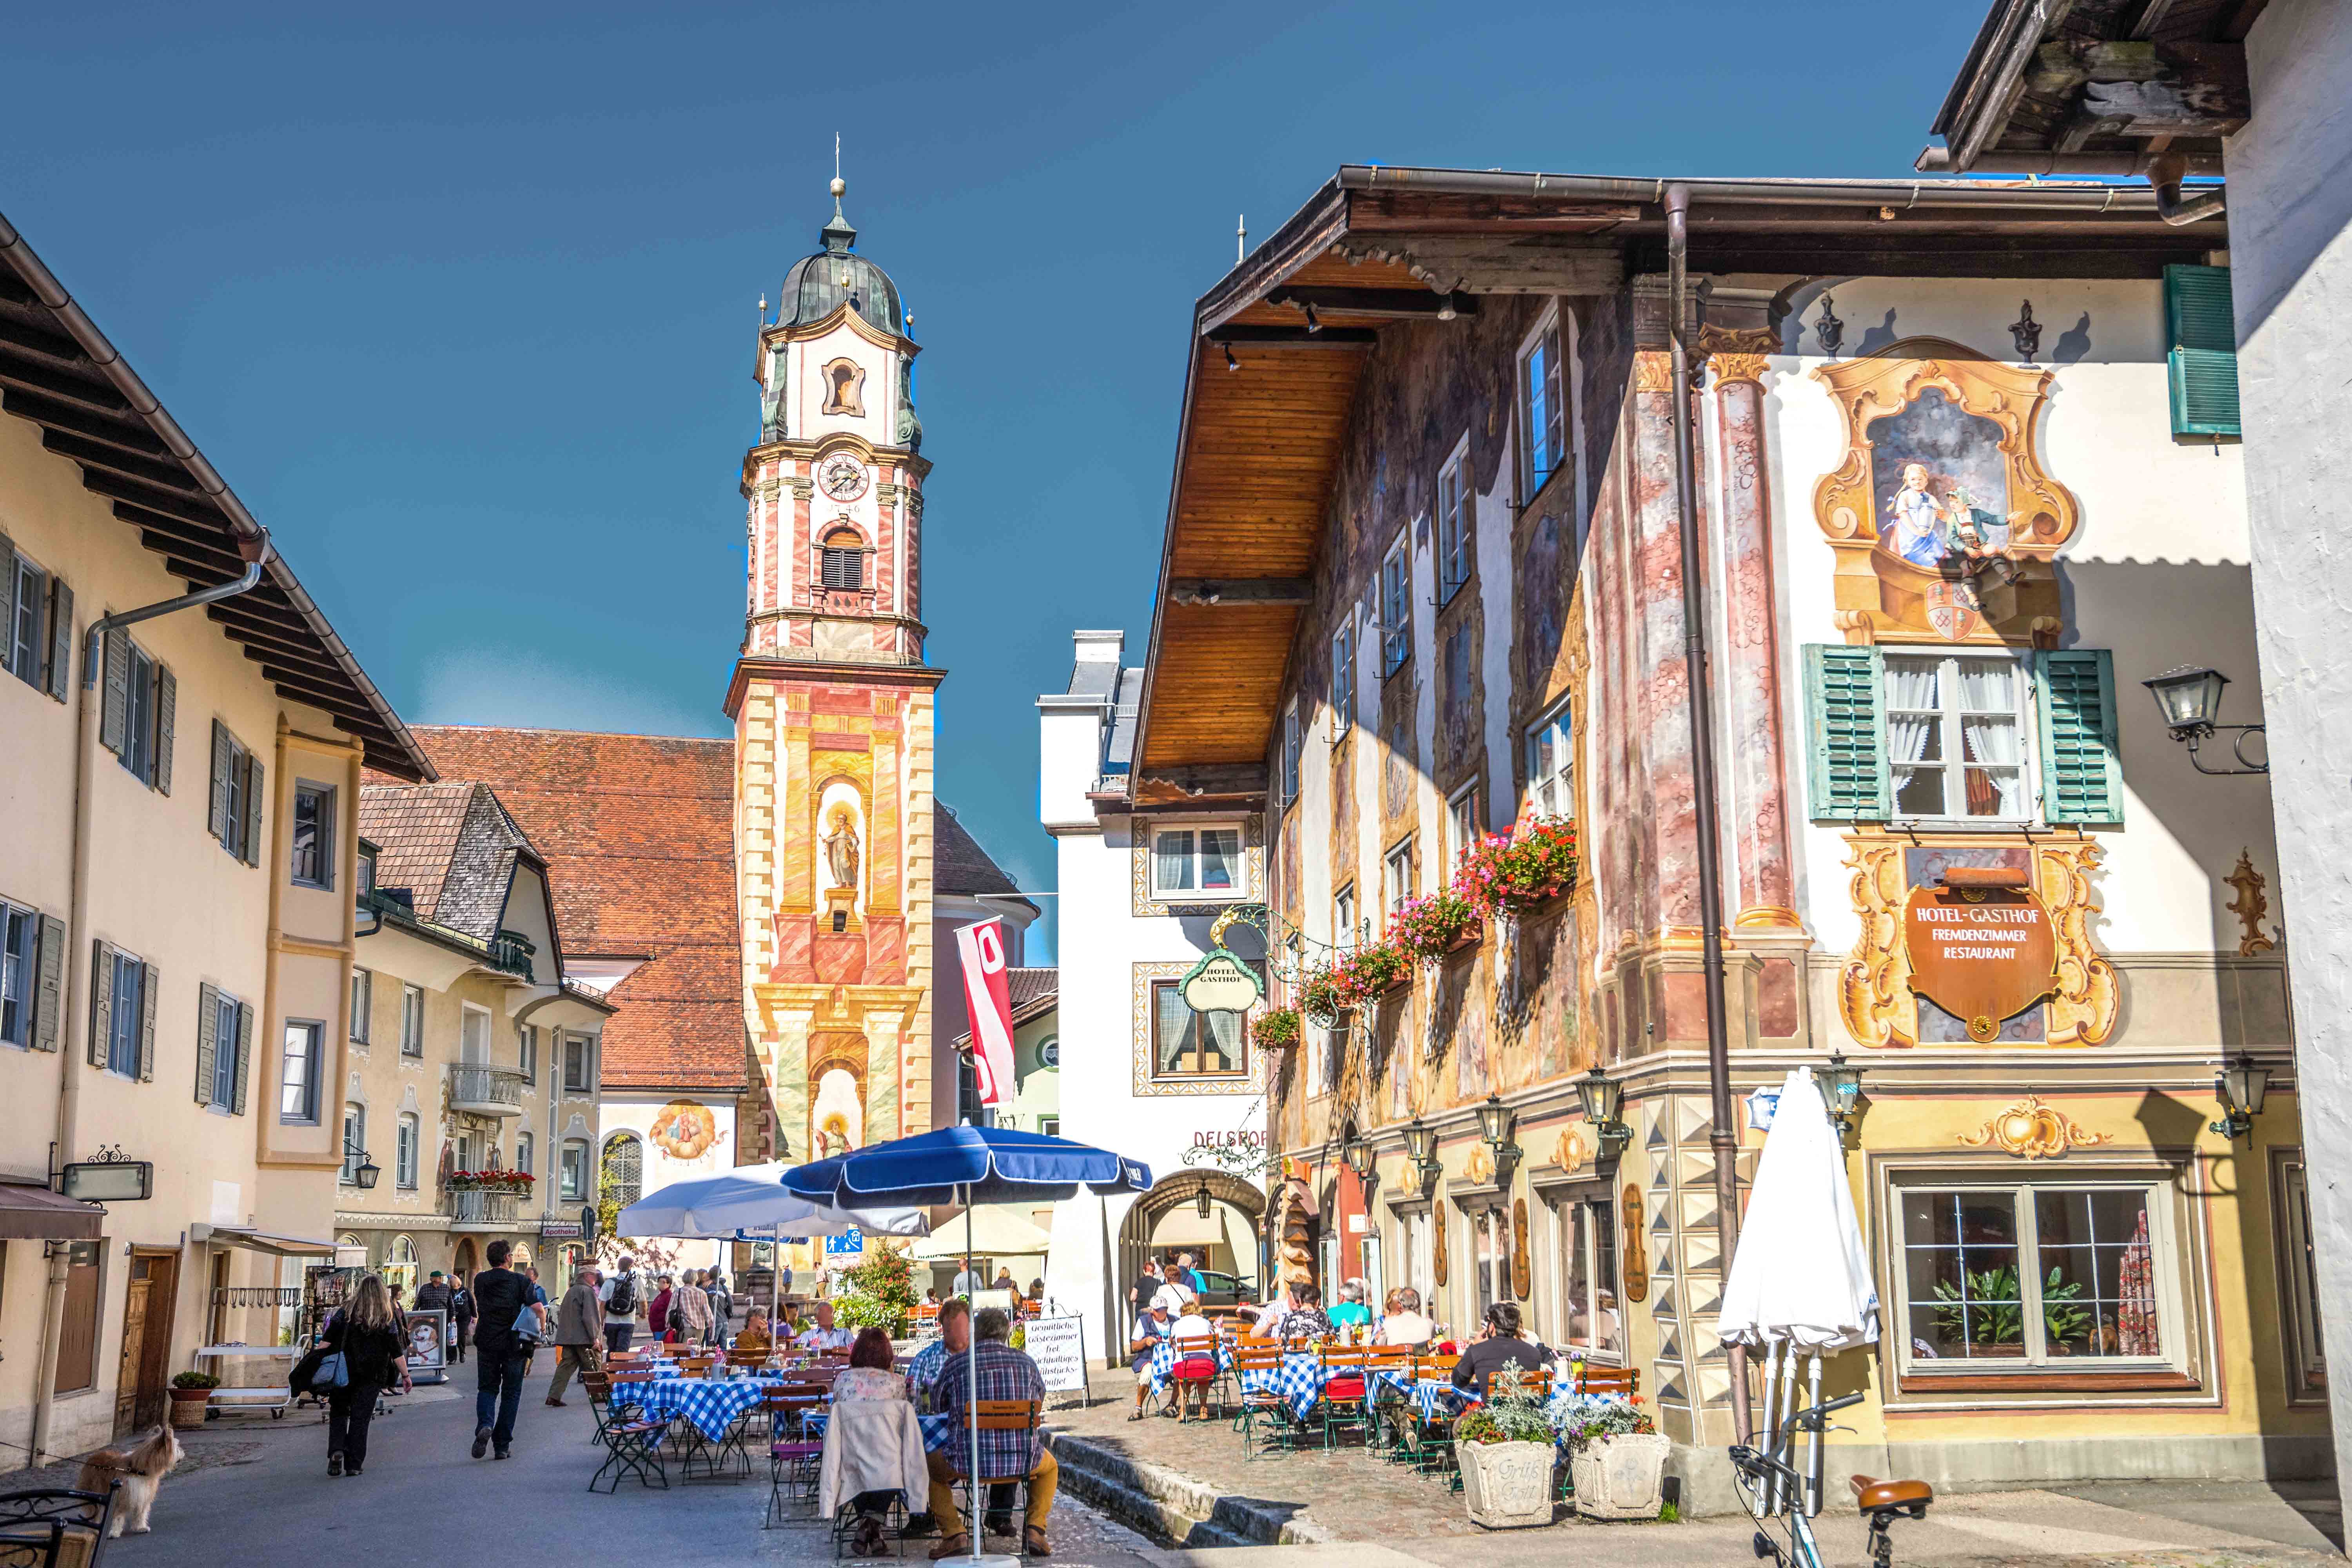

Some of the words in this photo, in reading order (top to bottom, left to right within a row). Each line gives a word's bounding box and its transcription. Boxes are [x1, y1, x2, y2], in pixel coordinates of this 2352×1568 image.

[1932, 929, 2026, 942] FREMDENZIMMER
[1944, 947, 2016, 959] RESTAURANT
[1031, 1321, 1074, 1332] Gemütliche
[1028, 1332, 1078, 1343] Gästezimmer
[1044, 1377, 1066, 1387] buffet
